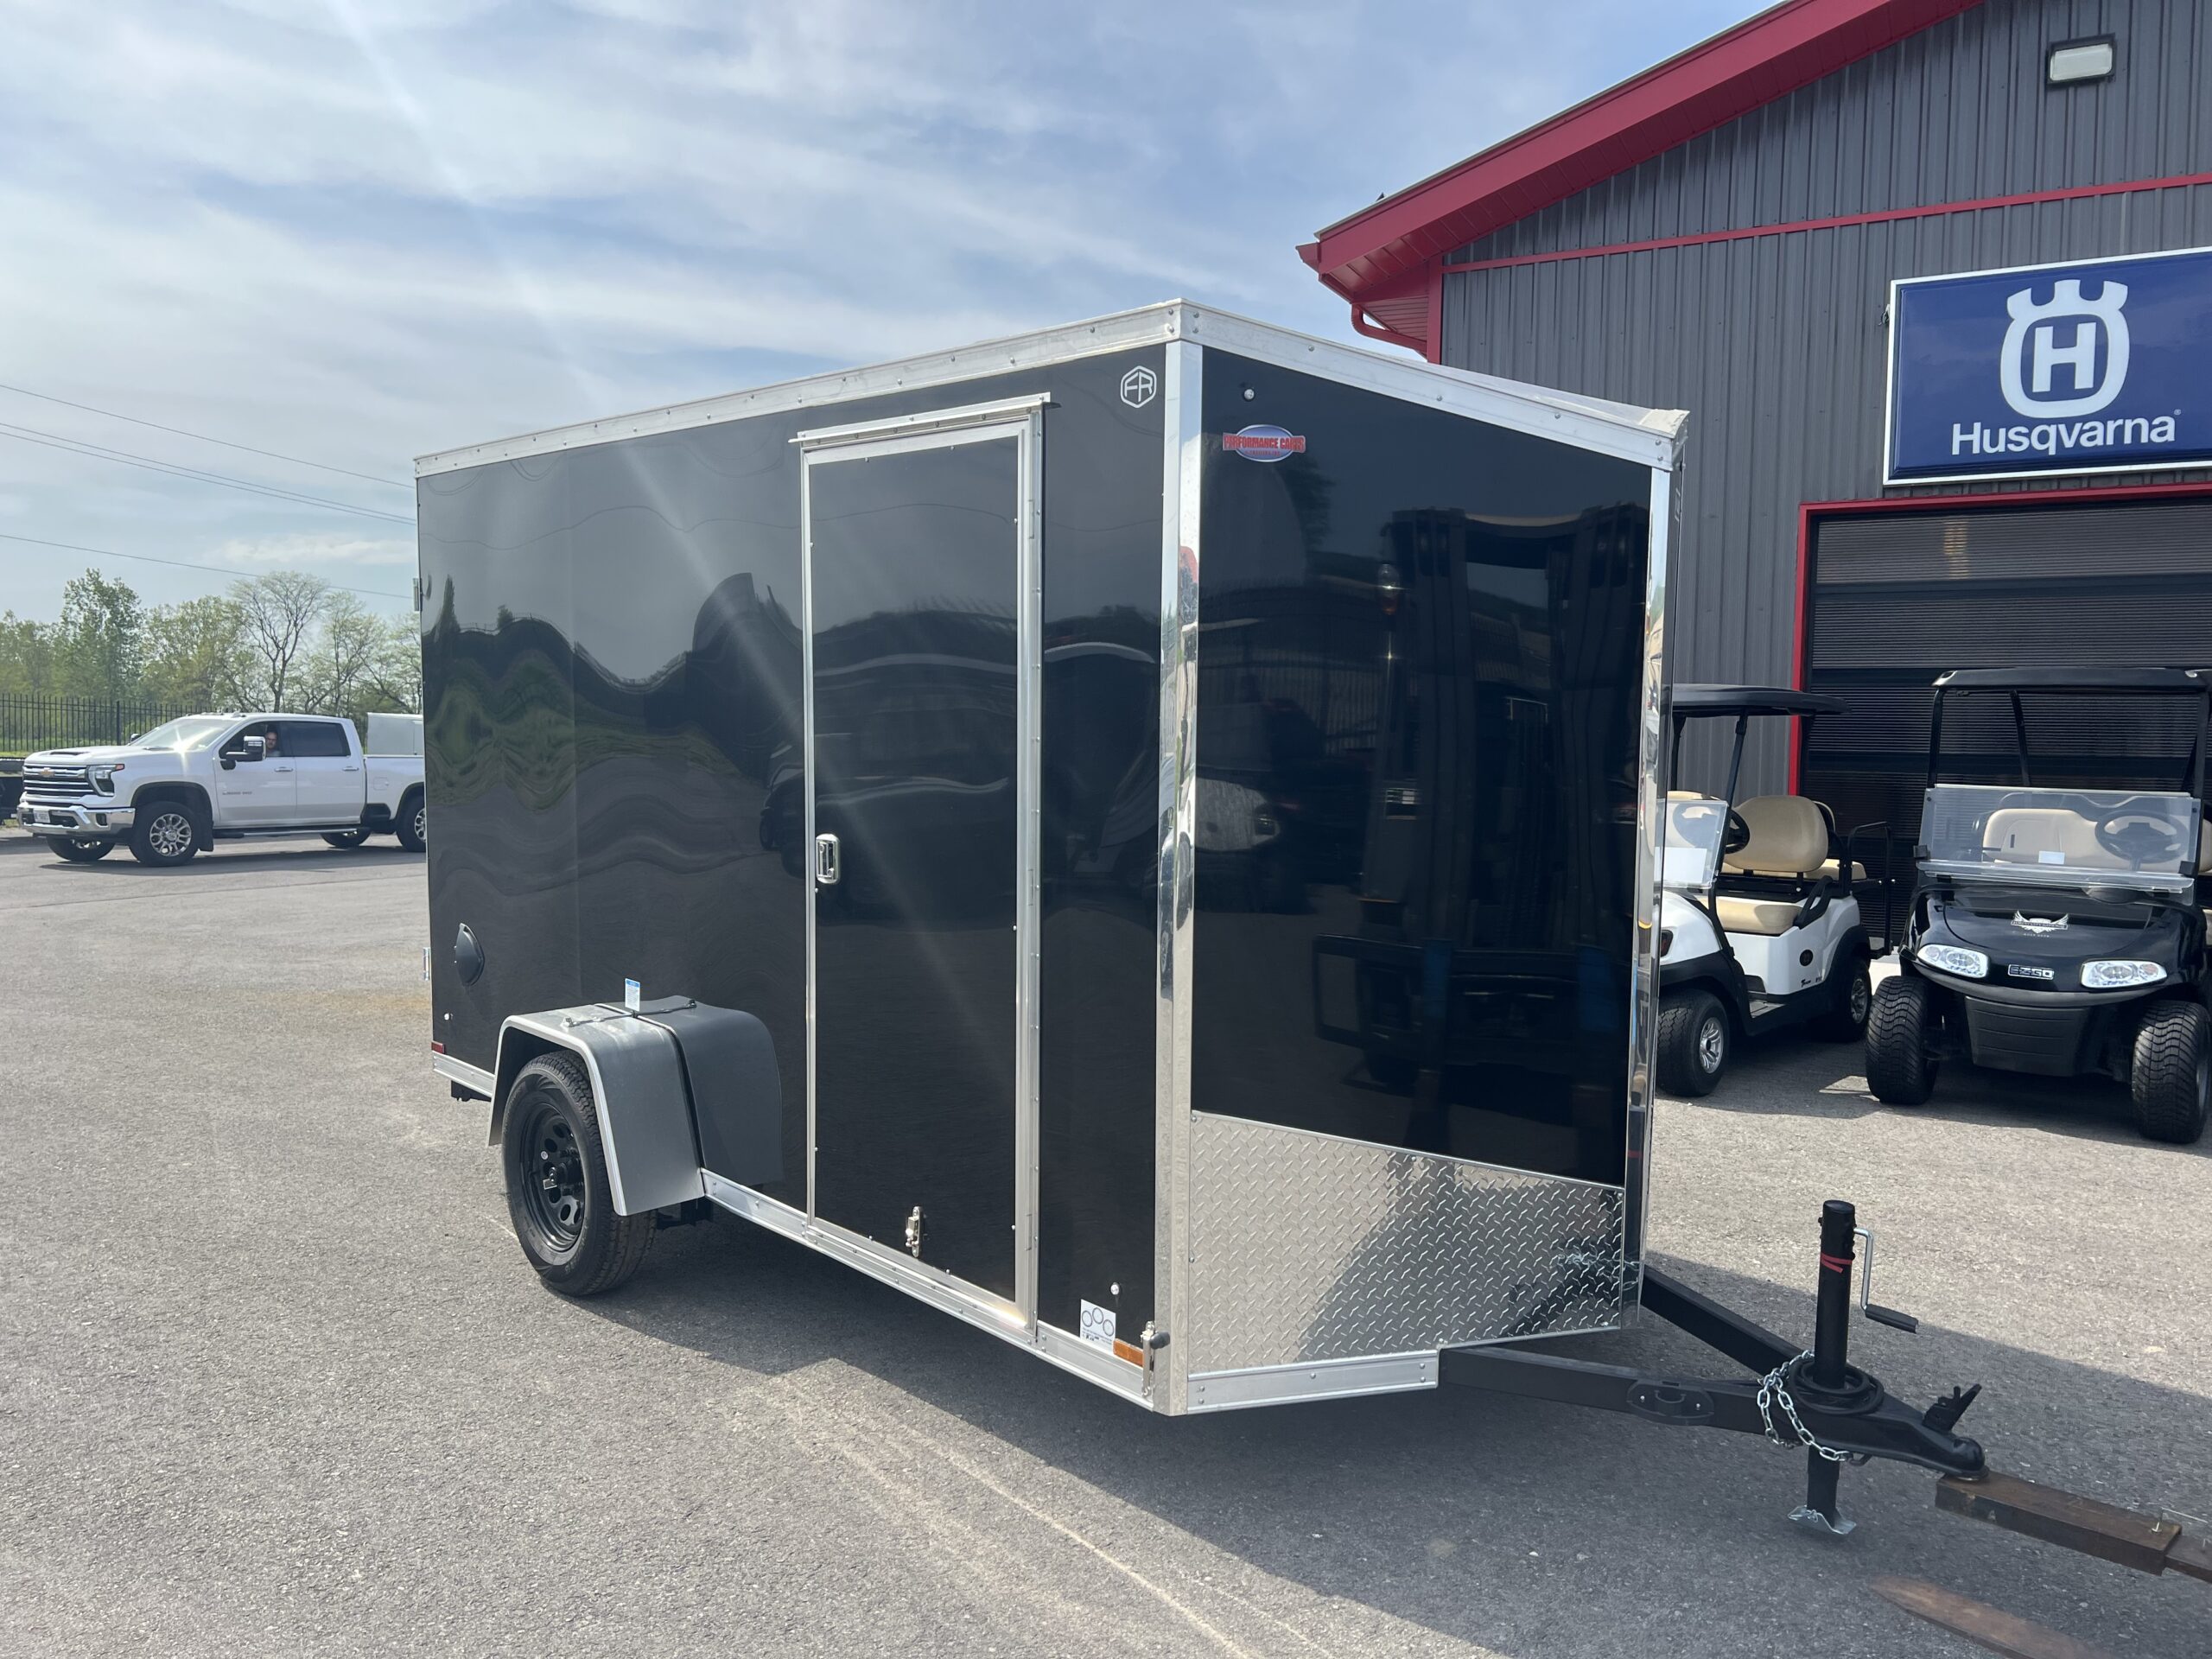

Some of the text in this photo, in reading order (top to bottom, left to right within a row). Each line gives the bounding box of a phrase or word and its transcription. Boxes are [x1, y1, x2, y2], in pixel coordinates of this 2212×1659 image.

[2032, 322, 2097, 392] H
[1224, 435, 1278, 448] PERFORMANCE
[1951, 416, 2176, 455] Husqvarna
